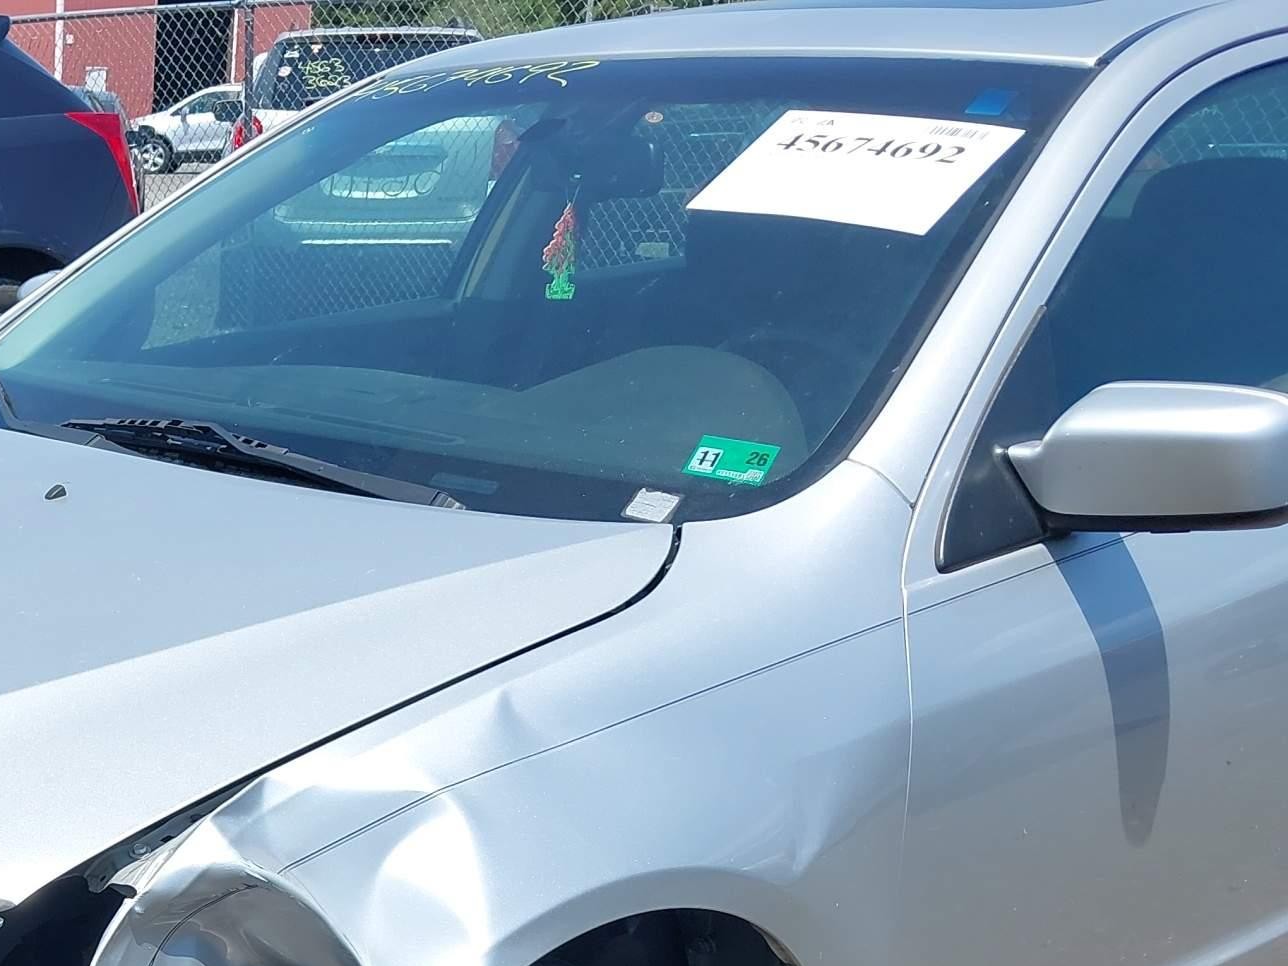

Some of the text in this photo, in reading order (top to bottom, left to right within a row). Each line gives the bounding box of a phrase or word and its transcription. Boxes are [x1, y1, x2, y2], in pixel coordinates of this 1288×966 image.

[298, 57, 345, 75] 4563
[777, 133, 966, 164] 45674692
[746, 451, 770, 467] 26
